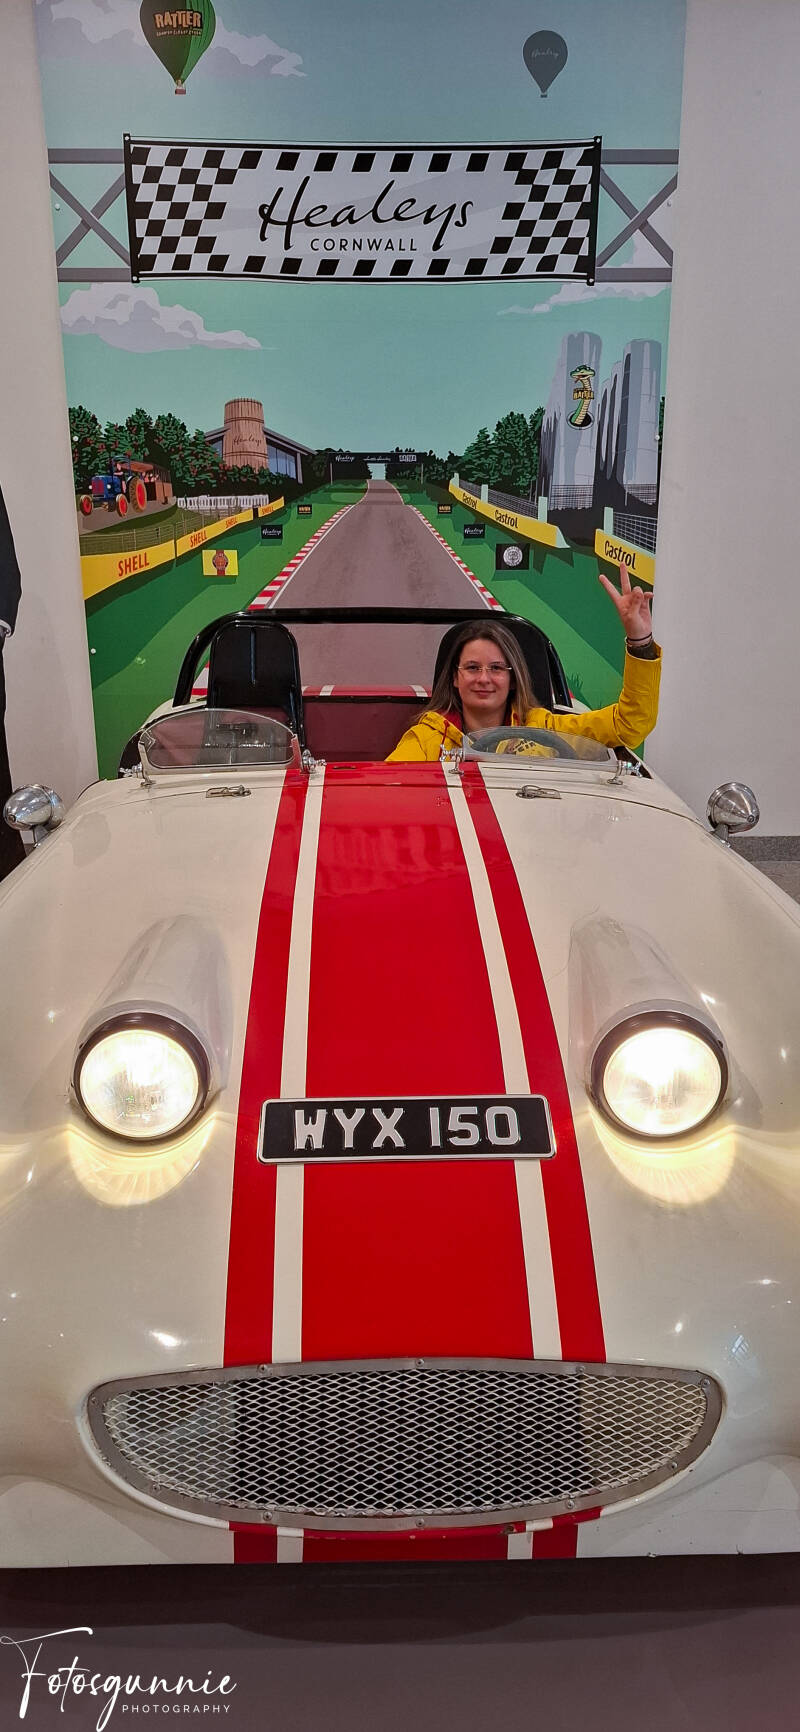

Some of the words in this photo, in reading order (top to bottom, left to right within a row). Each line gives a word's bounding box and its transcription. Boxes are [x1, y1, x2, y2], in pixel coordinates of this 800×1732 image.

[154, 11, 202, 28] RATTLER
[258, 175, 474, 251] Healeys
[310, 238, 418, 251] CORNWALL
[462, 492, 478, 510] Castrol
[494, 509, 518, 529] Castrol
[189, 530, 207, 548] SHELL
[118, 552, 150, 577] SHELL
[604, 540, 636, 570] Castrol
[294, 1106, 406, 1150] WYX
[429, 1105, 521, 1148] 150
